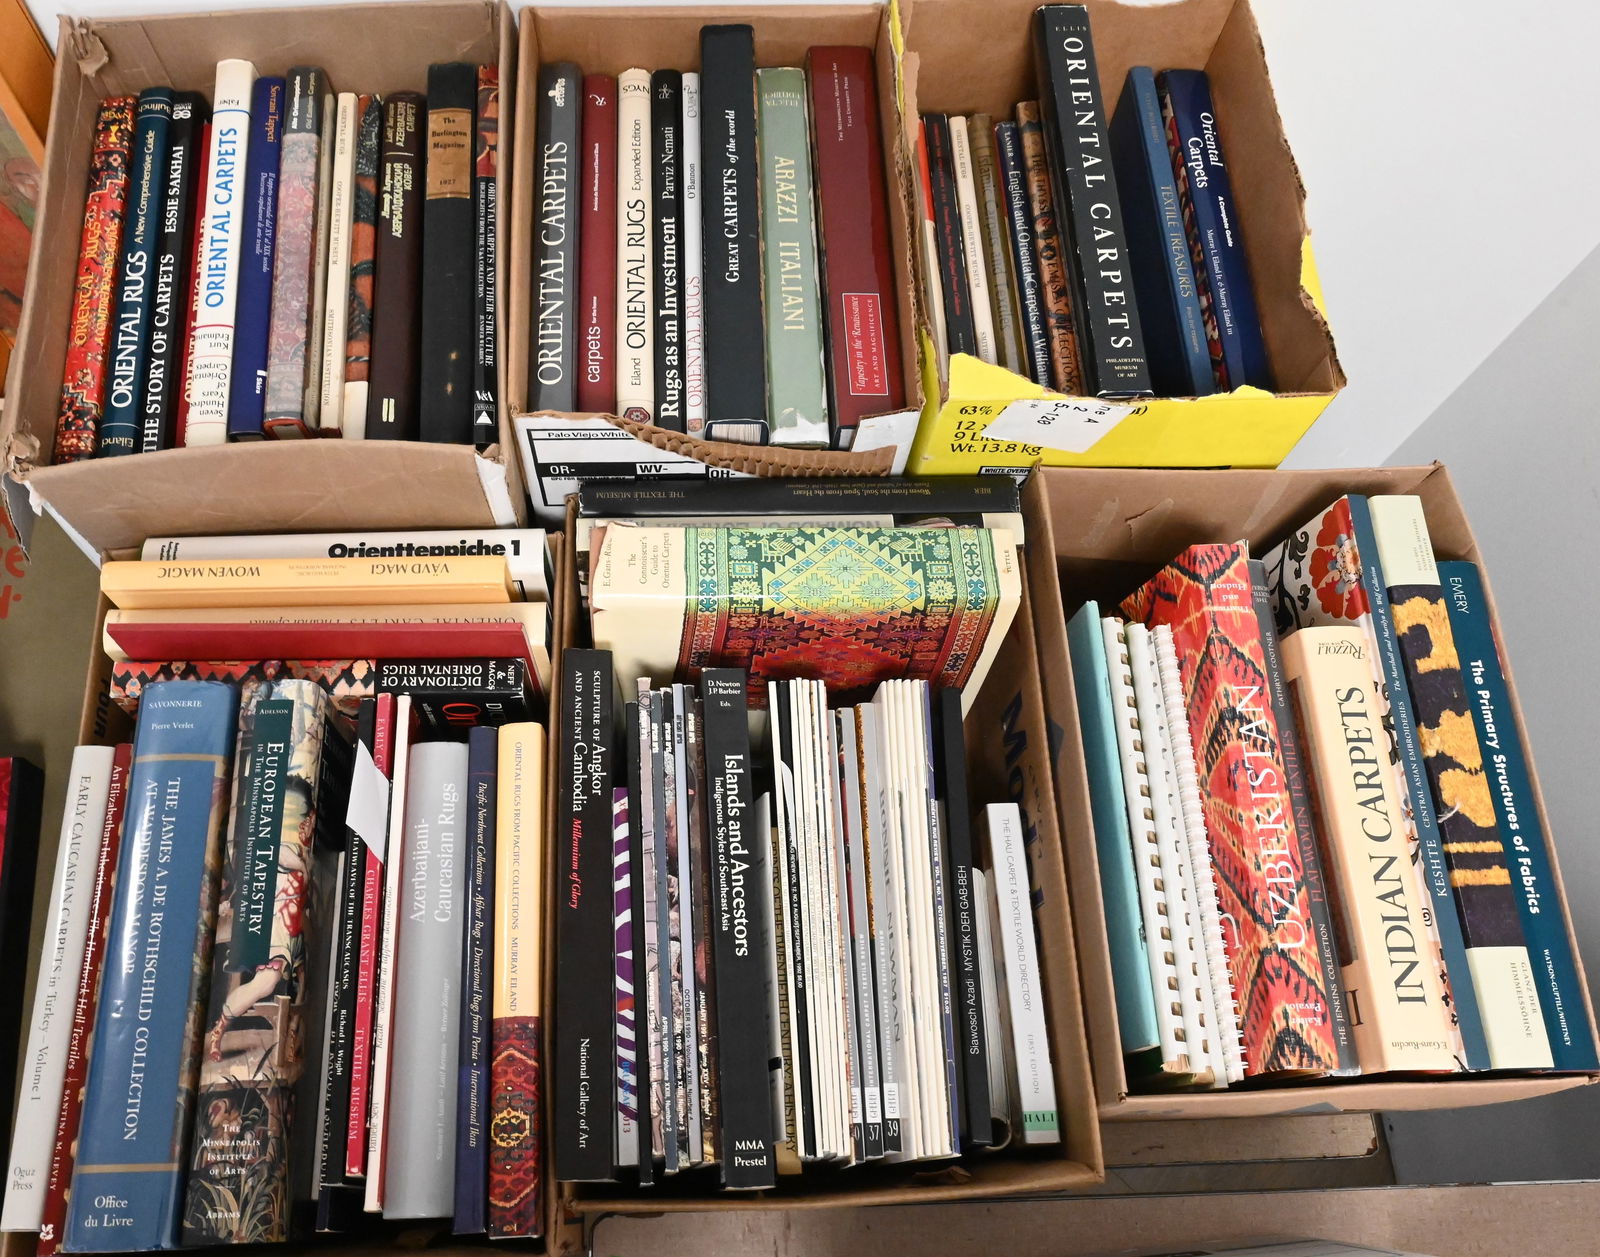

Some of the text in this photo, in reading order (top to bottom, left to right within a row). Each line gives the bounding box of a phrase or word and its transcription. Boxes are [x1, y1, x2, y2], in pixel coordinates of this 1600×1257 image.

[265, 85, 279, 142] Sovrani Tappeti
[622, 84, 650, 94] NYGS
[431, 130, 468, 138] Burlington
[432, 142, 465, 150] Magazine
[1200, 112, 1223, 166] Oriental
[134, 129, 155, 243] A New Comprehensive Guide
[165, 146, 183, 233] ESSIE SAKHAI
[1008, 170, 1024, 208] English
[1188, 137, 1208, 188] Carpets
[205, 128, 237, 308] ORIENTAL CARPETS
[723, 110, 739, 282] GREAT CARPETS of the world
[1014, 209, 1028, 229] and
[1063, 37, 1132, 348] ORIENTAL CARPETS
[774, 156, 804, 330] ARAZZI ITALIANI
[1160, 184, 1192, 298] TEXTILE TREASURES
[1219, 201, 1229, 229] Complete
[1224, 229, 1233, 247] Guide
[485, 182, 495, 366] ORIENTAL CARPETS AND THEIR STRUCTURE
[538, 142, 567, 385] ORIENTAL CARPETS
[626, 119, 645, 385] Eiland ORIENTAL RUGS Expanded Edition
[659, 127, 682, 417] Rugs as an Investment Parviz Nemati
[1018, 232, 1035, 277] Oriental
[686, 275, 701, 318] RUGS
[851, 296, 861, 337] Renaissance
[1024, 279, 1040, 322] Carpets
[111, 250, 147, 408] ORIENTAL RUGS
[853, 339, 862, 349] the
[867, 299, 876, 352] MAGNIFICENCE
[1031, 323, 1042, 334] at
[142, 254, 174, 453] THE STORY OF CARPETS
[586, 326, 603, 382] carpets
[687, 322, 702, 407] ORIENTAL
[855, 360, 868, 390] Tapestry
[959, 405, 993, 416] 63%
[101, 437, 134, 448] Eiland
[550, 465, 576, 474] OR-
[639, 464, 668, 473] WV-
[950, 443, 1043, 456] Wt. 13.8 kg
[710, 469, 736, 478] OH-
[157, 566, 261, 578] WOVEN MAGIC
[370, 563, 449, 577] VÄVD MAGI
[1449, 577, 1469, 614] EMERY
[382, 665, 483, 674] ORIENTAL RUGS
[1317, 641, 1366, 660] RIZZOLI
[149, 700, 203, 710] SAVONNERIE
[381, 676, 482, 687] DICTIONARY OF
[574, 695, 582, 740] ANCIENT
[588, 670, 605, 795] SCULPTURE OF Angkor
[572, 742, 587, 811] Cambodia
[1398, 701, 1430, 827] CENTRAL ASIAN EMBROIDERIES
[1470, 660, 1540, 914] The Primary Structures of Fabrics
[248, 742, 284, 935] EUROPEAN TAPESTRY
[476, 782, 486, 884] Pacific Northwest Collections
[1229, 683, 1307, 952] UZBEKISTAN
[410, 818, 432, 923] Azerbaijani-
[434, 783, 458, 922] Caucasian Rugs
[568, 818, 581, 909] Millennium of Glory
[713, 777, 729, 930] Indigenous Styles of Southeast Asia
[724, 754, 749, 956] Islands and Ancestors
[1335, 687, 1427, 1006] INDIAN CARPETS
[1426, 840, 1448, 896] KESHTE
[124, 777, 180, 1140] THE JAMES A. DE ROTHSCHILD COLLECTION
[957, 866, 979, 1054] Siawosch Azadi MYSTIK DER GAB-BEH
[577, 1038, 589, 1147] National Gallery of Art
[734, 1156, 767, 1167] Prestel
[735, 1140, 765, 1150] MMA
[85, 1215, 133, 1228] du Livre
[94, 1196, 128, 1209] Office
